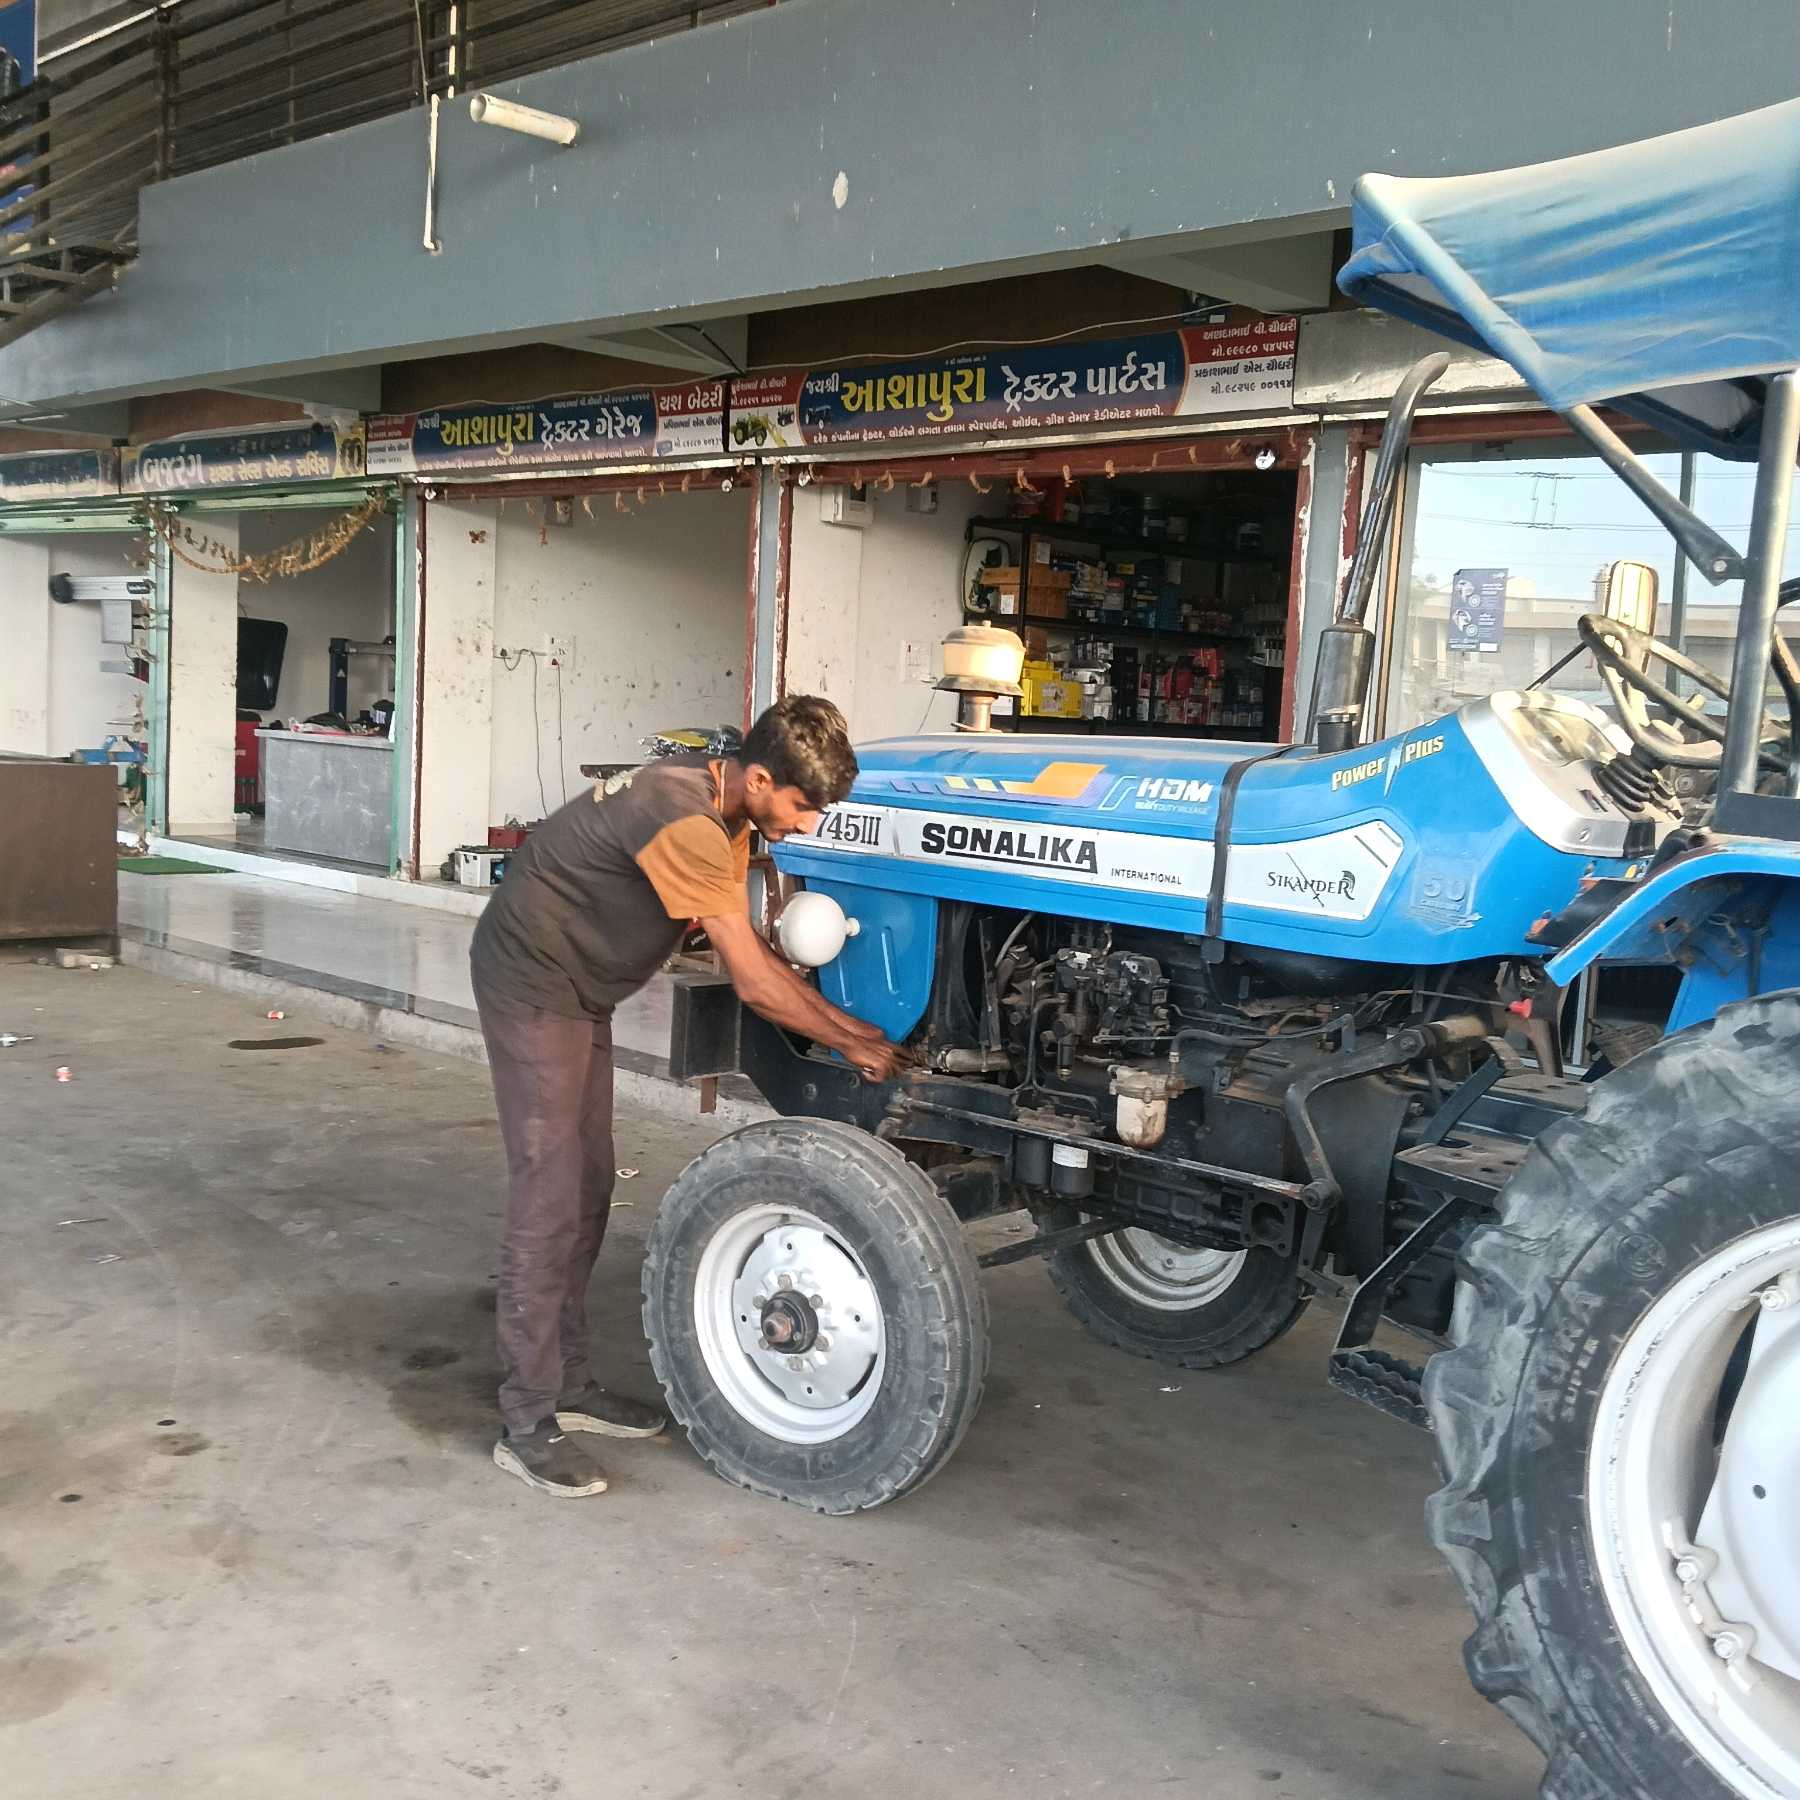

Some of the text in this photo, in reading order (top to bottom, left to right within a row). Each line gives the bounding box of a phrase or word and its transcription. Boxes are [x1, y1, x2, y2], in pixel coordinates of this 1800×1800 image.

[660, 393, 682, 412] યશ
[688, 384, 723, 410] બેટરી
[806, 372, 840, 395] જયશ્રી
[841, 367, 987, 422] આશાપુરા
[441, 411, 534, 456] આશાપુરા
[595, 406, 643, 440] ગેરેજ
[1331, 735, 1444, 791] Power Plus
[1136, 777, 1214, 803] HDM
[921, 822, 1183, 885] SONALIKA INTERNATIONAL
[1267, 870, 1356, 901] SIKANDER
